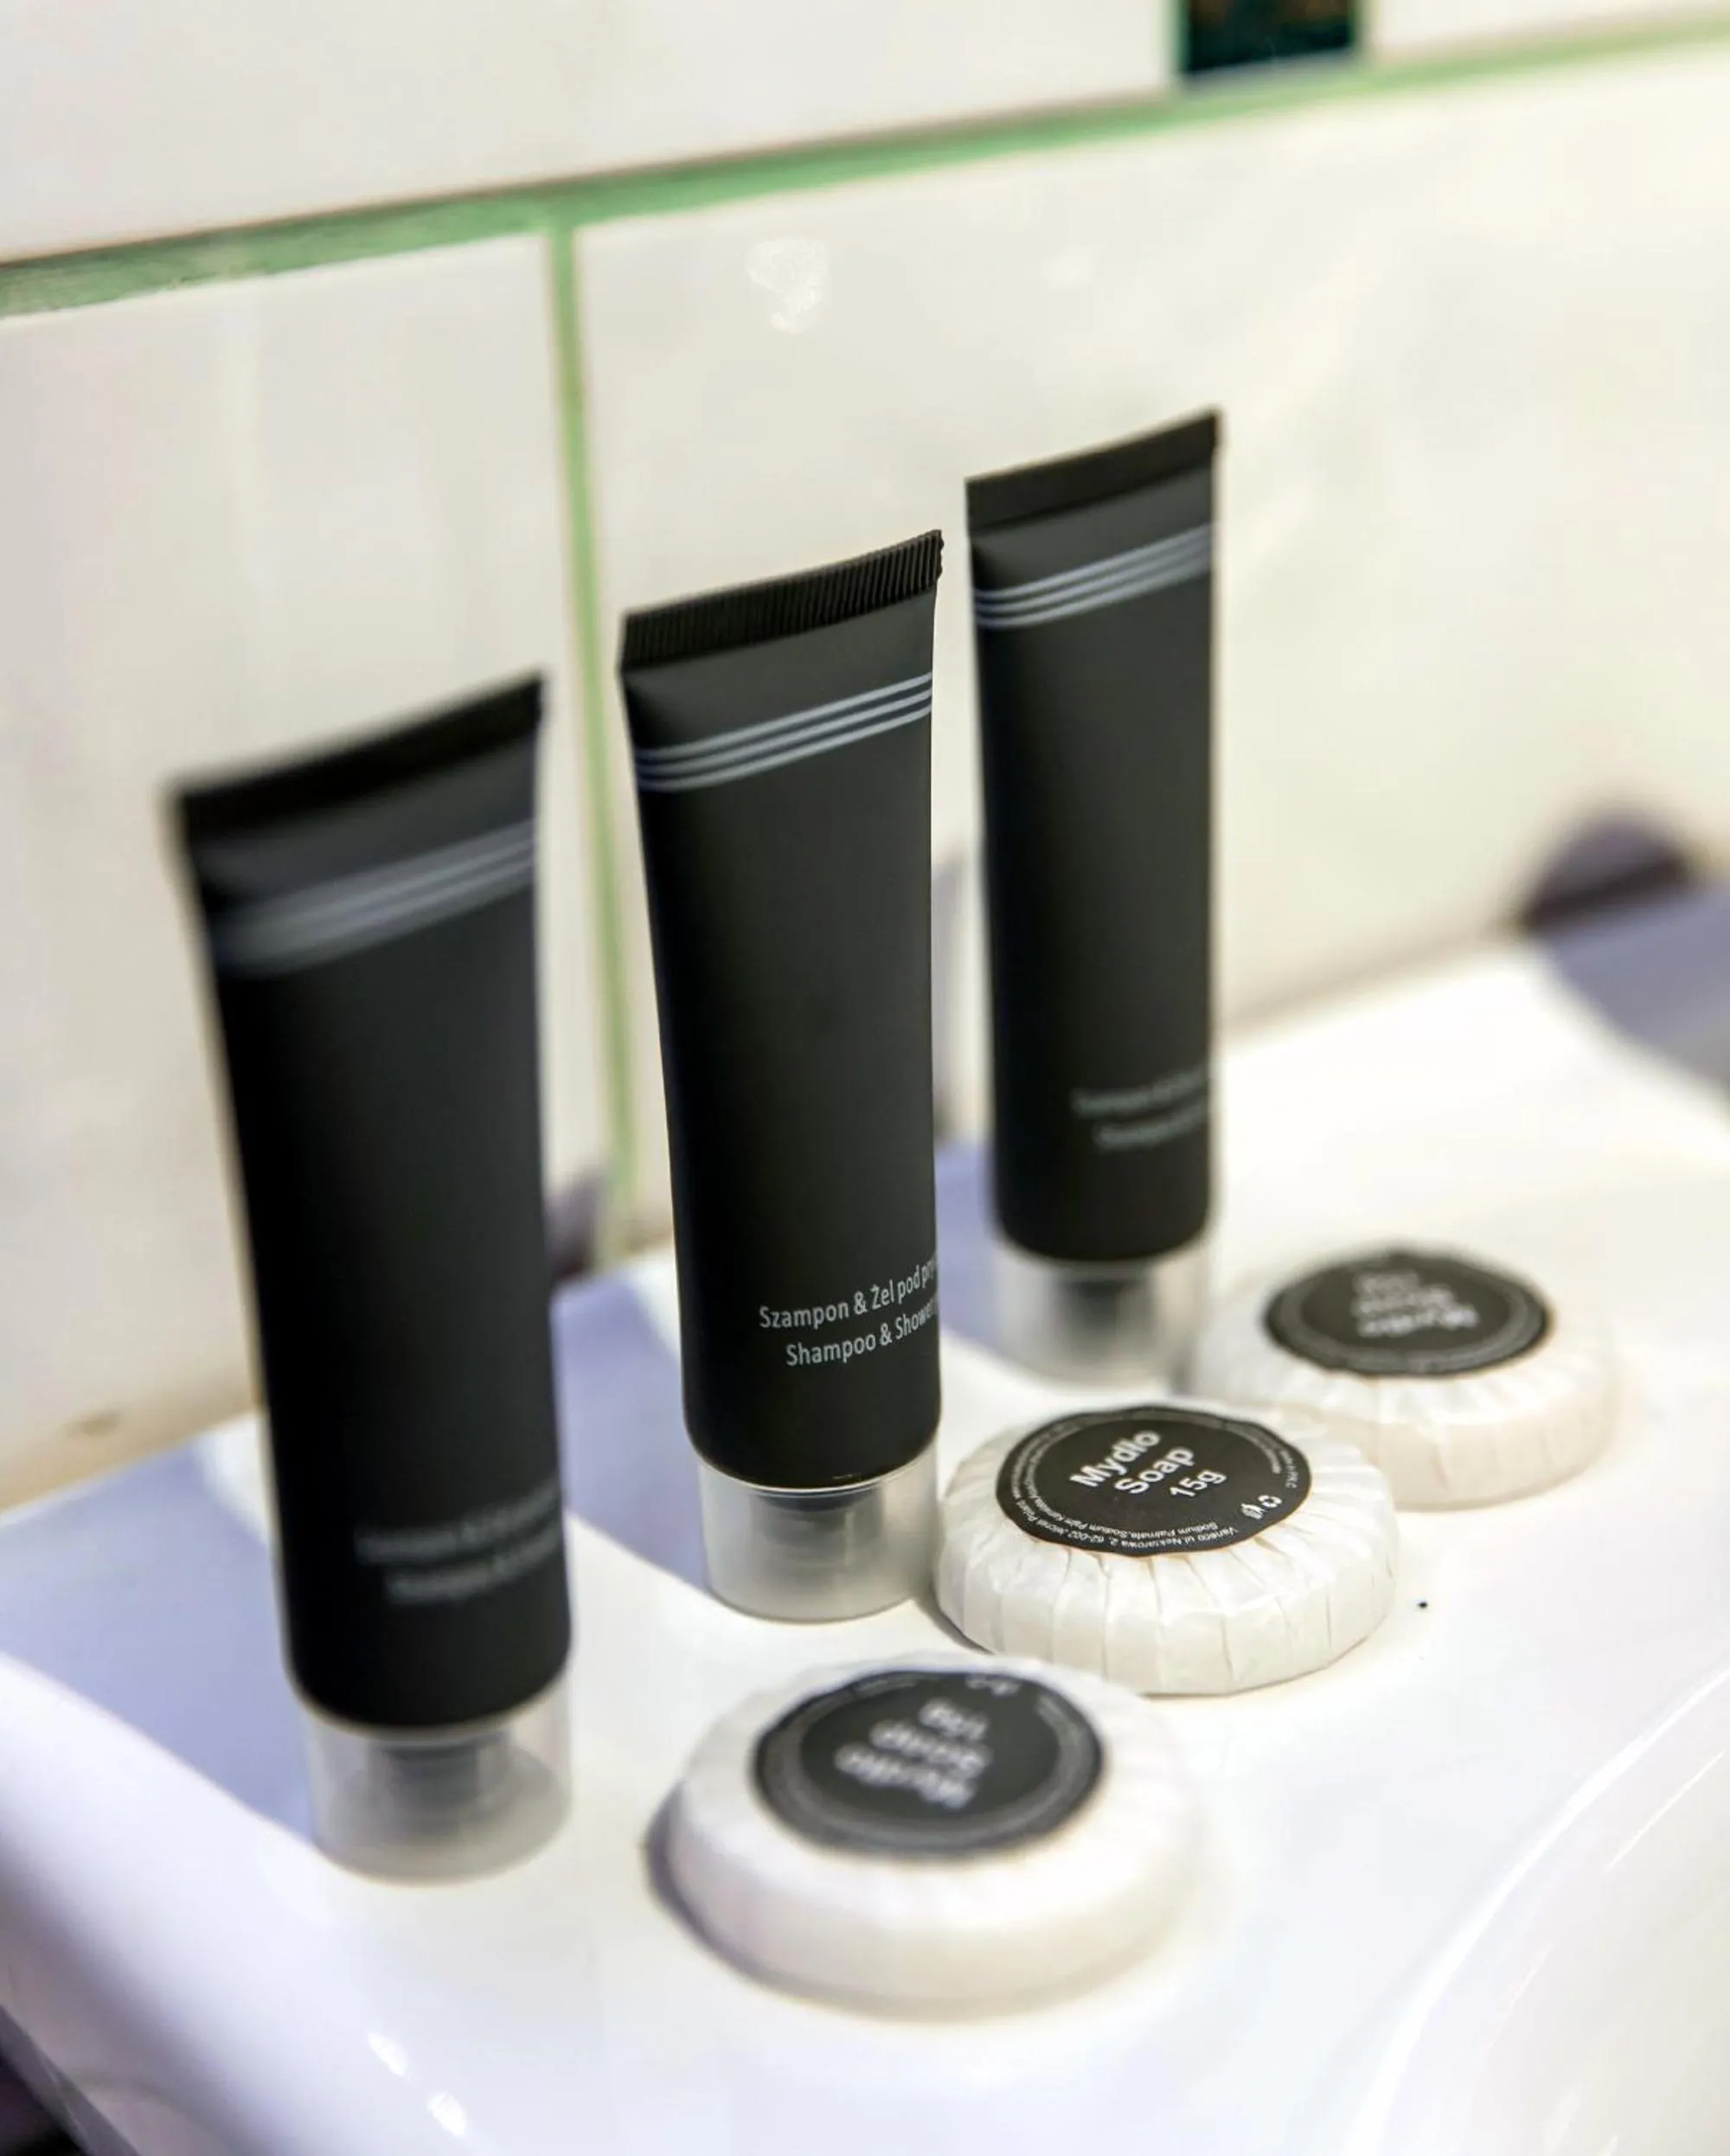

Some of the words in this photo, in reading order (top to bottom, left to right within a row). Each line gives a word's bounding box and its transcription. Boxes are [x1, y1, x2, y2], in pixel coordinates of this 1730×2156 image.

[759, 1301, 849, 1330] Szampon
[853, 1291, 867, 1315] &
[870, 1280, 894, 1310] Żel
[897, 1264, 920, 1305] pod
[785, 1334, 876, 1366] Shampoo
[880, 1322, 893, 1346] &
[1114, 1447, 1195, 1494] Soap
[1169, 1470, 1227, 1498] 15g
